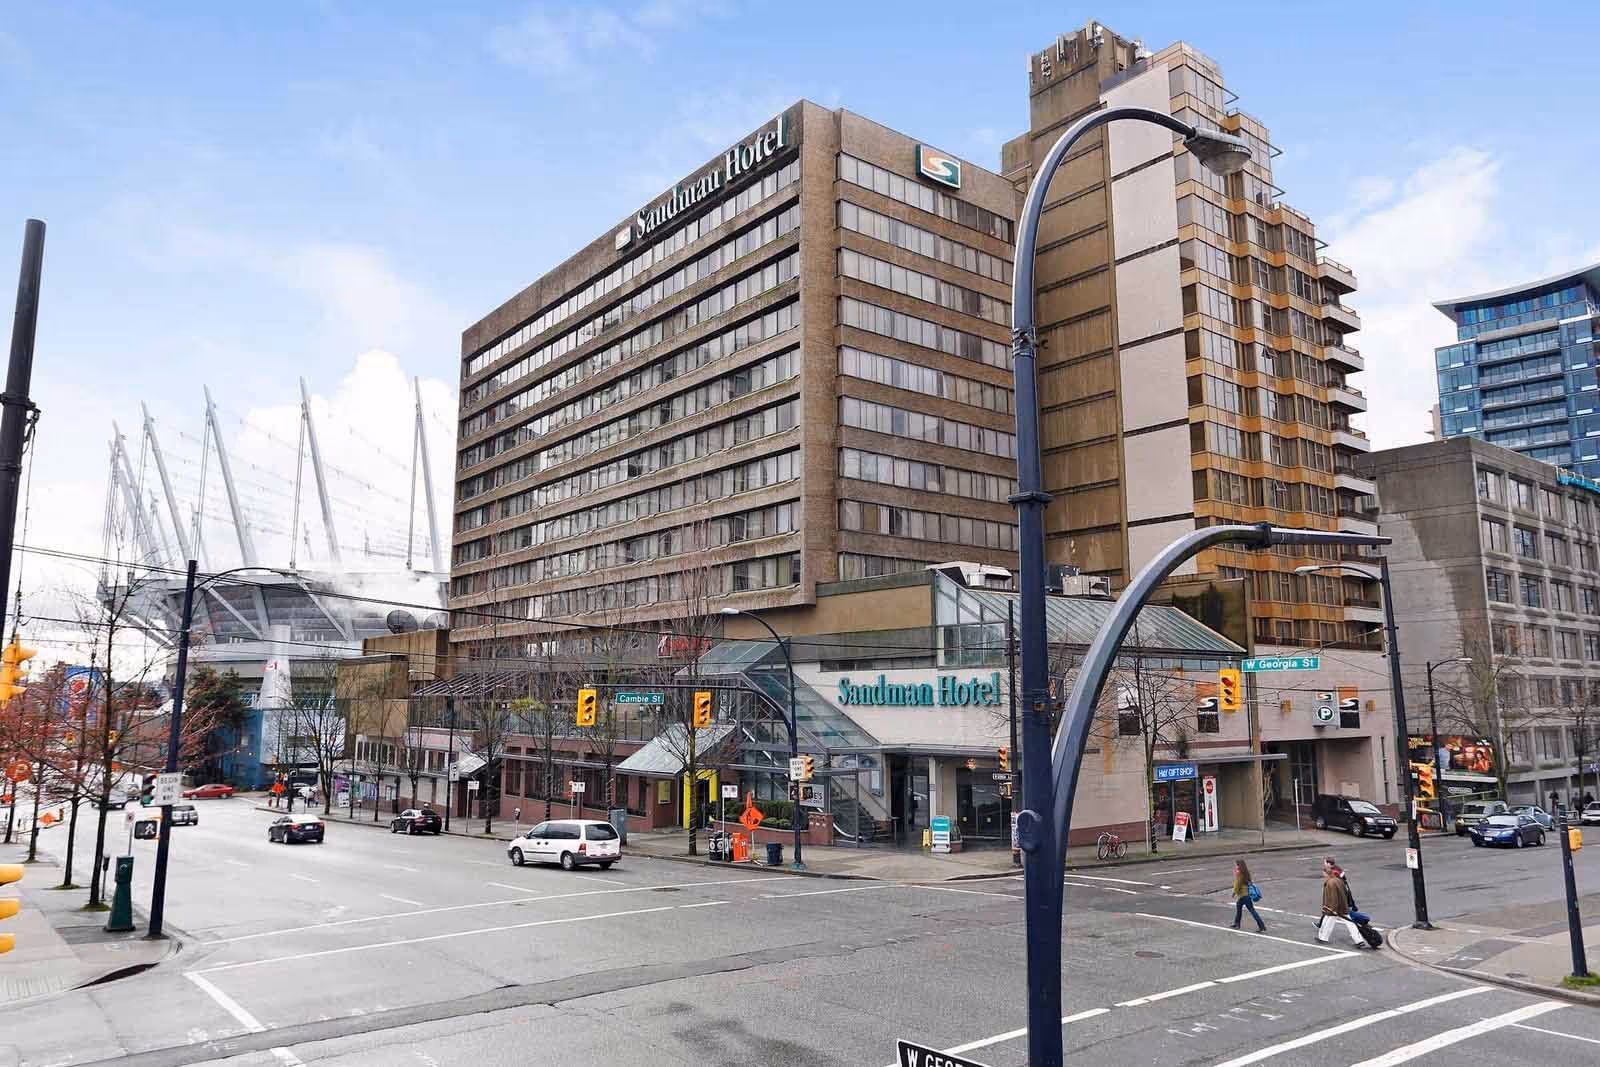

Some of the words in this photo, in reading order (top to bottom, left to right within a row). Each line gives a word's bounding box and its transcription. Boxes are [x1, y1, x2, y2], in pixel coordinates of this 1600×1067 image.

[636, 168, 722, 240] Sandman
[725, 115, 786, 182] Hotel
[1247, 660, 1256, 669] W
[1258, 660, 1298, 670] Georgia
[1303, 659, 1314, 668] St
[838, 674, 935, 707] Sandman
[937, 672, 1001, 707] Hotel
[619, 695, 649, 703] Cambie
[652, 695, 661, 703] St
[1168, 767, 1180, 777] GIFT
[1180, 767, 1194, 776] SHOP
